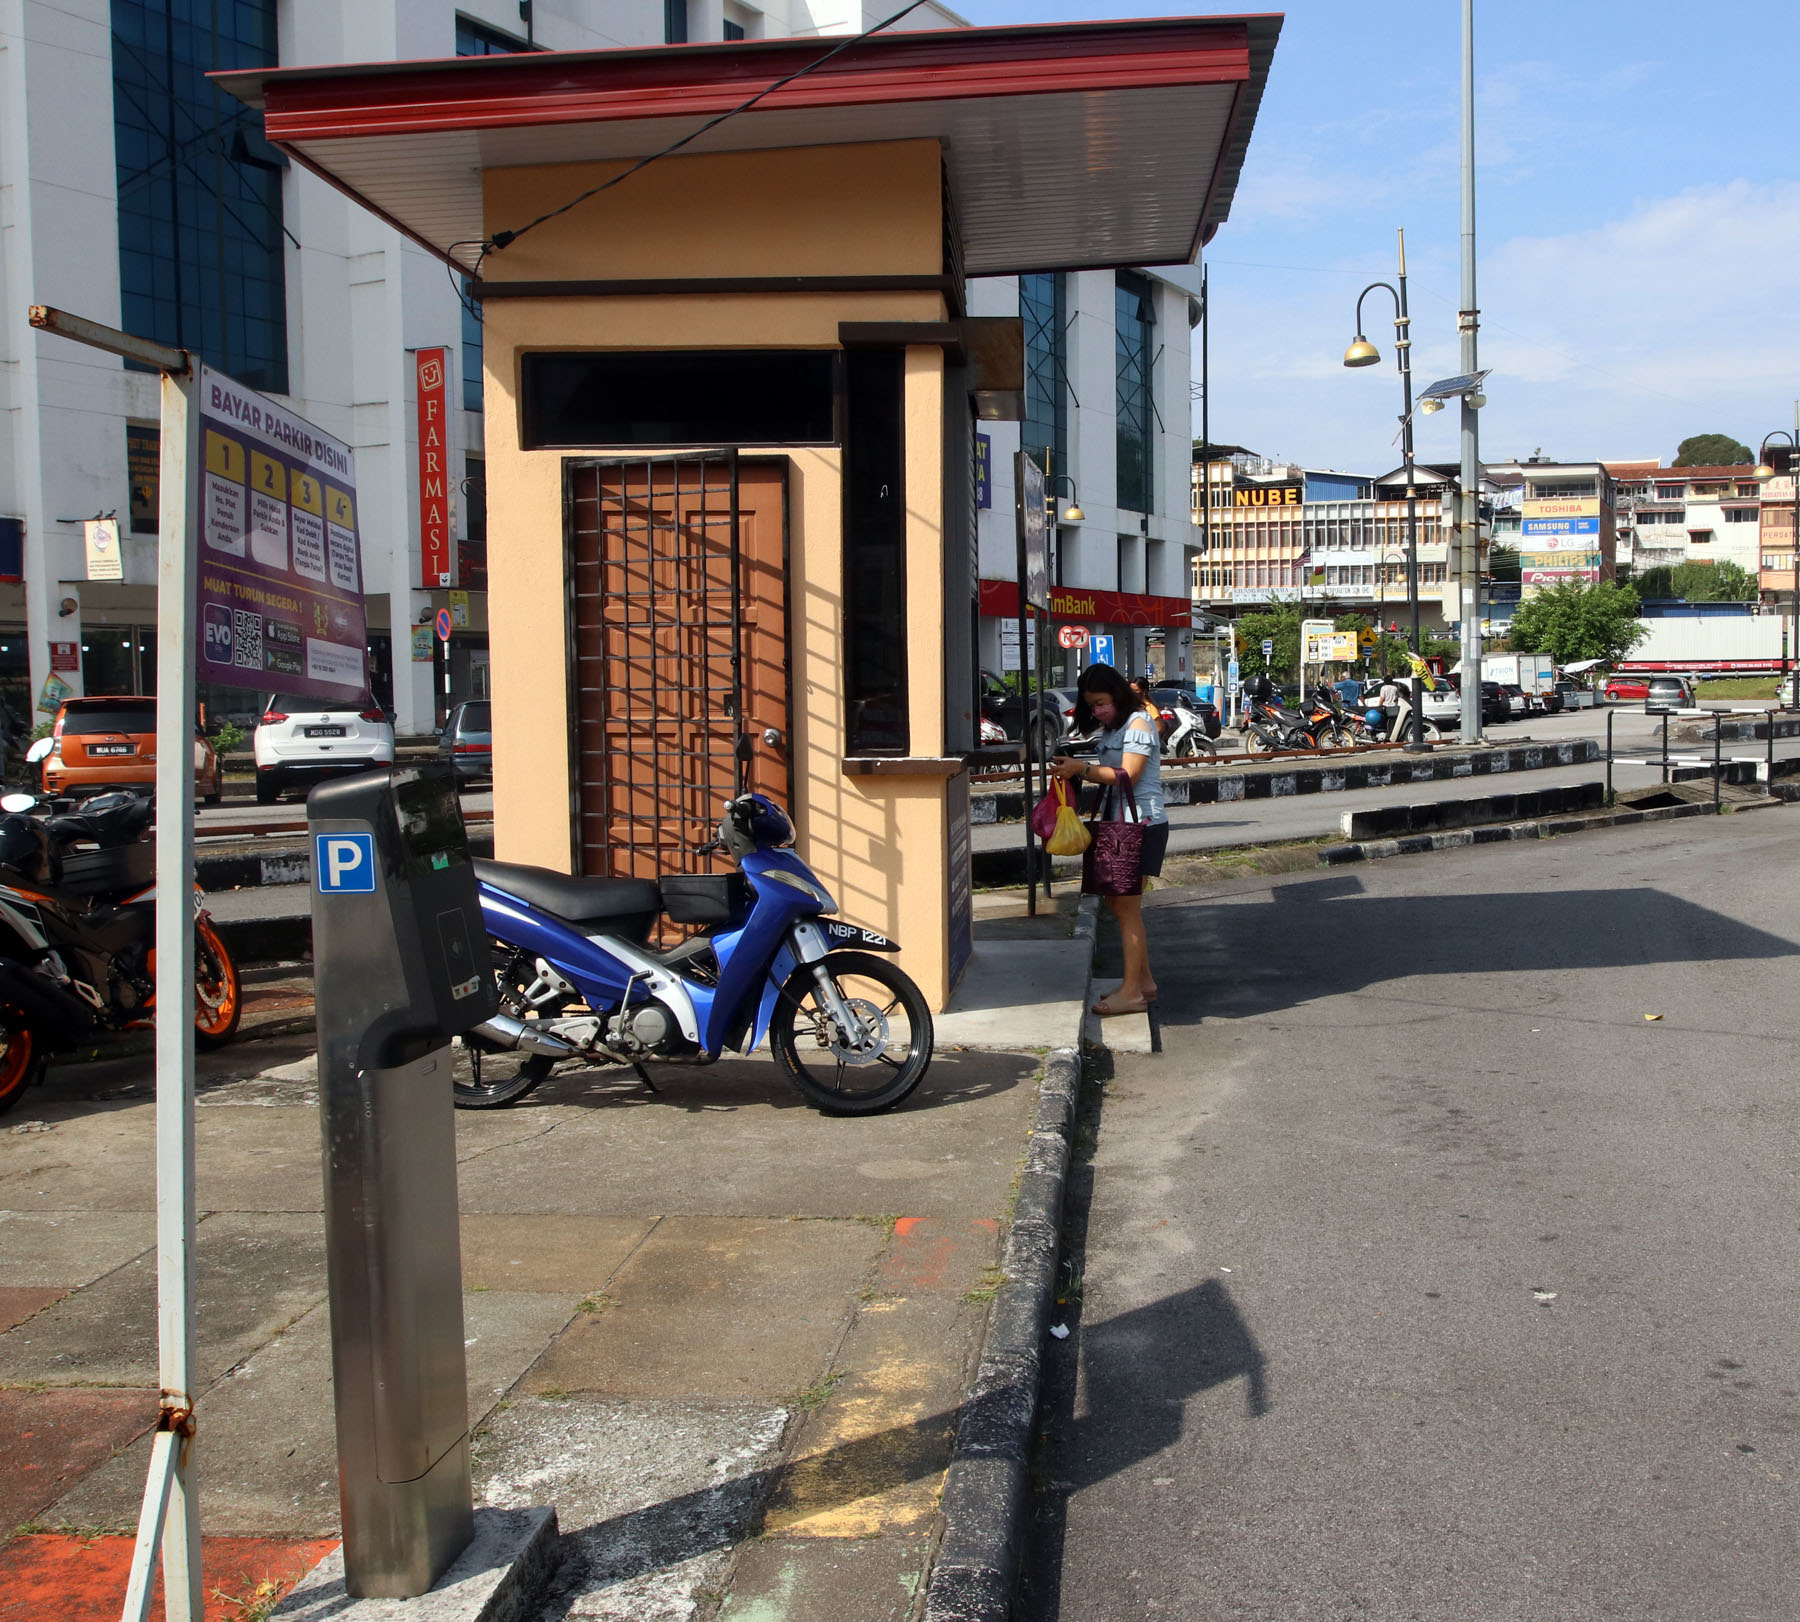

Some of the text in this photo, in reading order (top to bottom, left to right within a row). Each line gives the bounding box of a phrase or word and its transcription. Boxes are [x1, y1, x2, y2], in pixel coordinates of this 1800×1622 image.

[211, 384, 348, 475] BAYAR PARKIR DISINI
[223, 445, 230, 470] 1
[264, 464, 274, 489] 2
[303, 481, 311, 504] 3
[425, 399, 442, 576] FARMASI
[1236, 488, 1297, 506] NUBE
[336, 498, 345, 519] 4
[1539, 505, 1582, 513] TOSHIBA
[211, 518, 240, 534] Kenderaan
[296, 526, 305, 535] Kad
[1528, 522, 1569, 531] SAMSUNG
[1561, 538, 1574, 548] LG
[1535, 553, 1586, 567] PHILIPS
[204, 576, 232, 597] MUAT
[234, 584, 264, 604] TURUN
[266, 592, 298, 613] SEGERA
[1051, 595, 1096, 615] mBank
[205, 622, 231, 646] EVO
[277, 630, 301, 644] App Store
[1096, 637, 1107, 653] P
[277, 658, 293, 672] Google
[328, 841, 362, 887] P
[829, 923, 886, 946] NBP 1221
